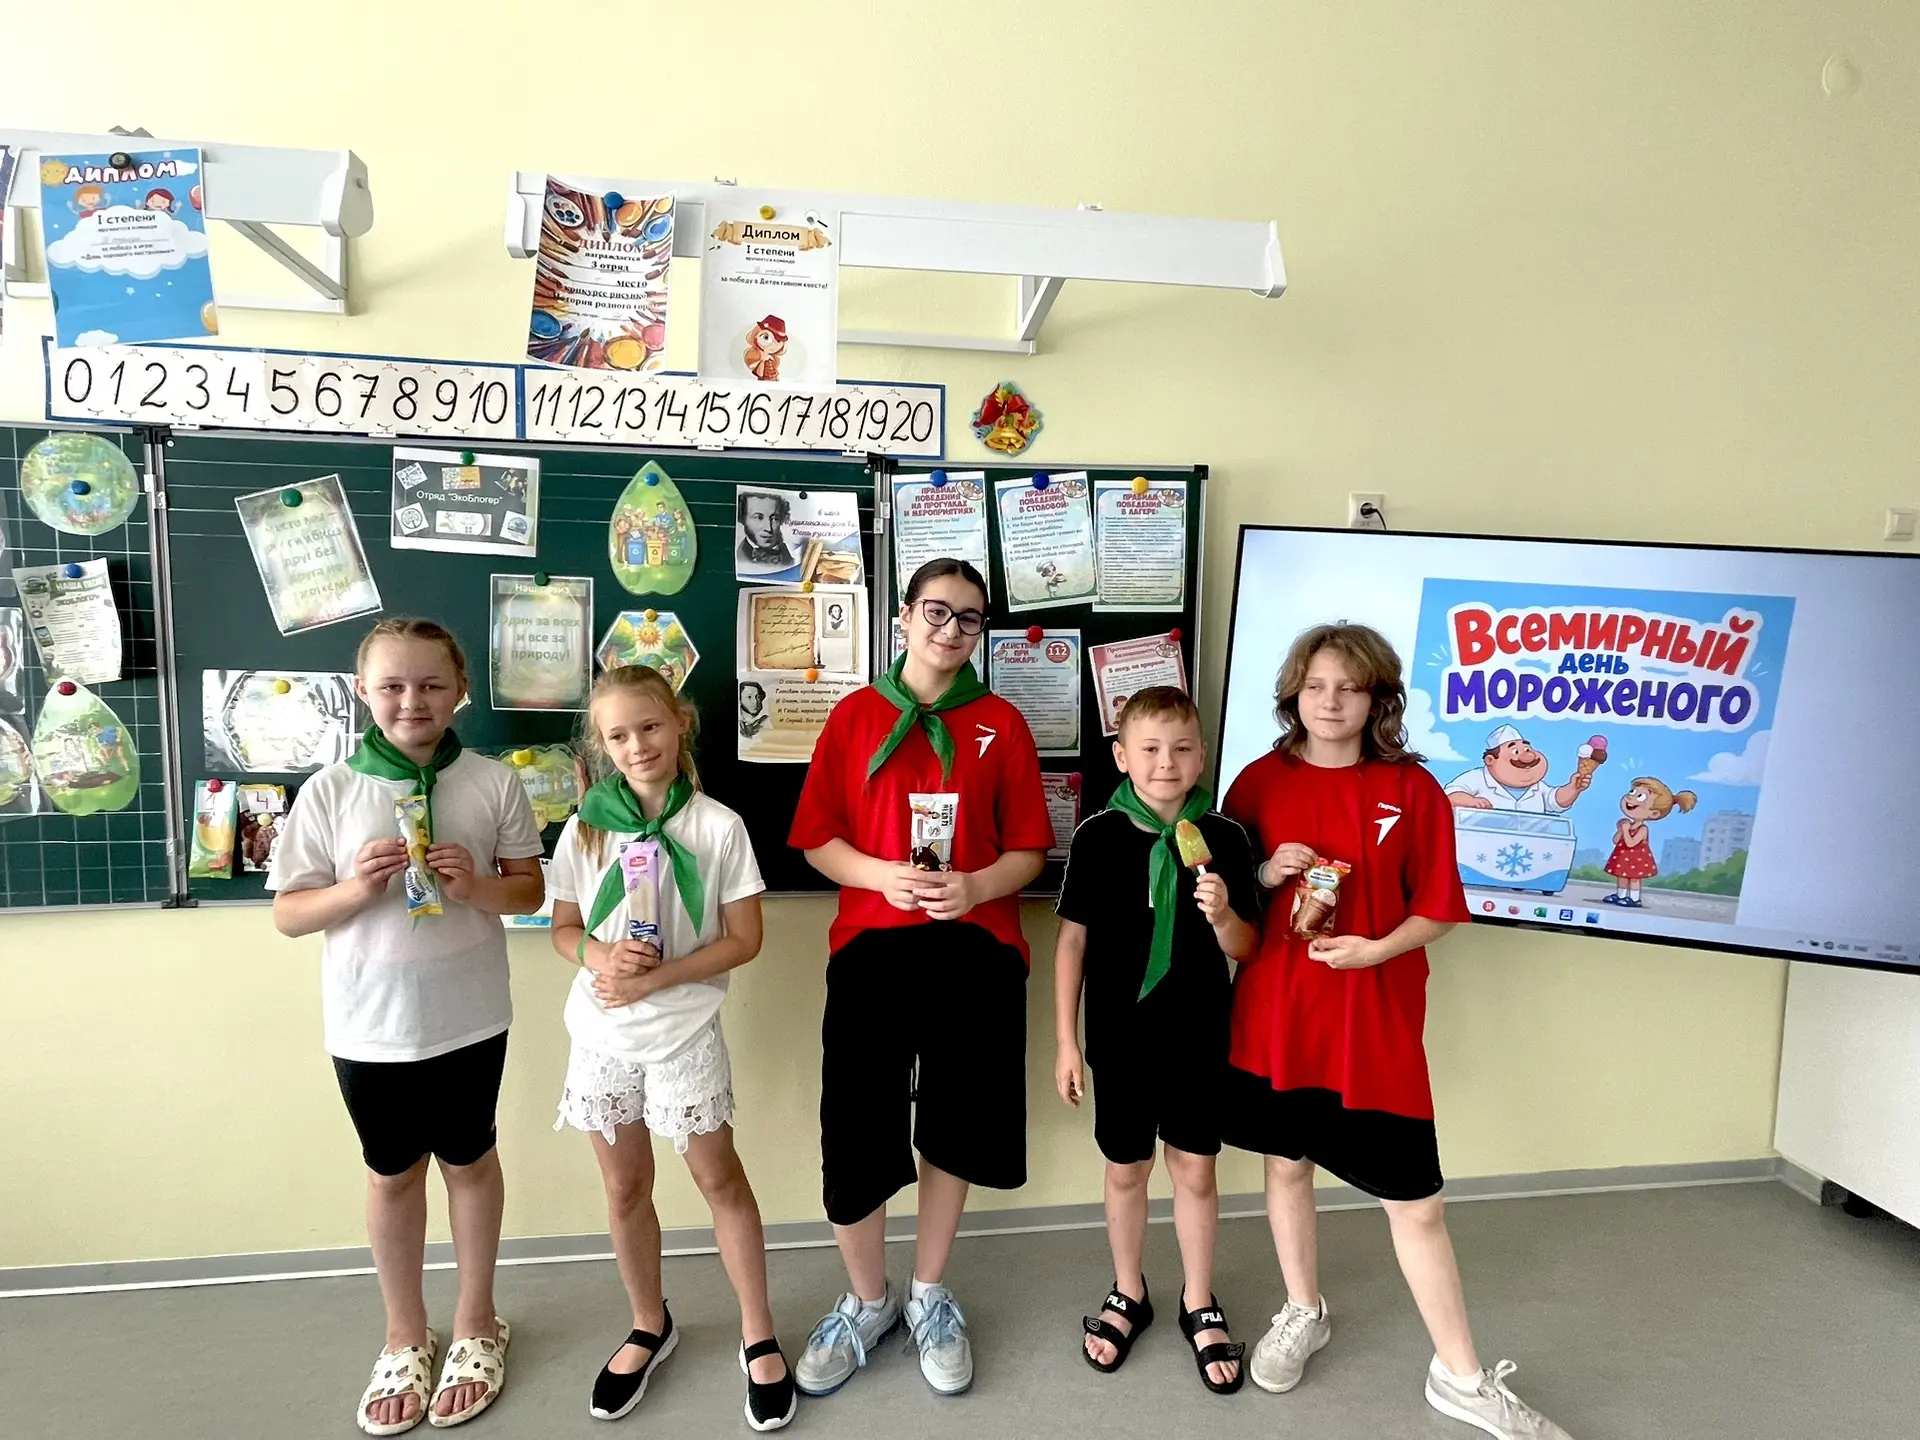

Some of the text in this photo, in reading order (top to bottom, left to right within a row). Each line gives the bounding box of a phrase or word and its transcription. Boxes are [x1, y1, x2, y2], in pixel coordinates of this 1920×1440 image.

[63, 160, 178, 185] ДИПЛОМ
[106, 214, 156, 224] степени
[742, 225, 800, 241] Диплом
[754, 247, 795, 257] степени
[591, 261, 629, 272] 3 отряд
[64, 358, 508, 424] 0 1 2 3 4 5 6 7 8 9 10
[532, 384, 934, 443] 11 12 13 14 15 16 17 18 19 20
[416, 490, 445, 501] Отряд
[921, 486, 956, 495] ПРАВИЛА
[1024, 487, 1060, 498] ПРАВИЛА
[915, 494, 961, 502] ПОВЕДЕНИЯ
[1019, 494, 1065, 506] ПОВЕДЕНИЯ
[1122, 493, 1158, 501] ПРАВИЛА
[924, 500, 968, 509] ПРОГУЛКАХ
[515, 583, 535, 593] Наш
[535, 618, 550, 627] за
[553, 618, 581, 628] всех
[516, 633, 566, 643] и все за
[511, 650, 571, 663] природу!
[1048, 647, 1072, 656] 112
[1558, 652, 1629, 676] день
[256, 790, 269, 810] 4
[1106, 1294, 1127, 1311] FILA
[1200, 1312, 1224, 1324] FILA
